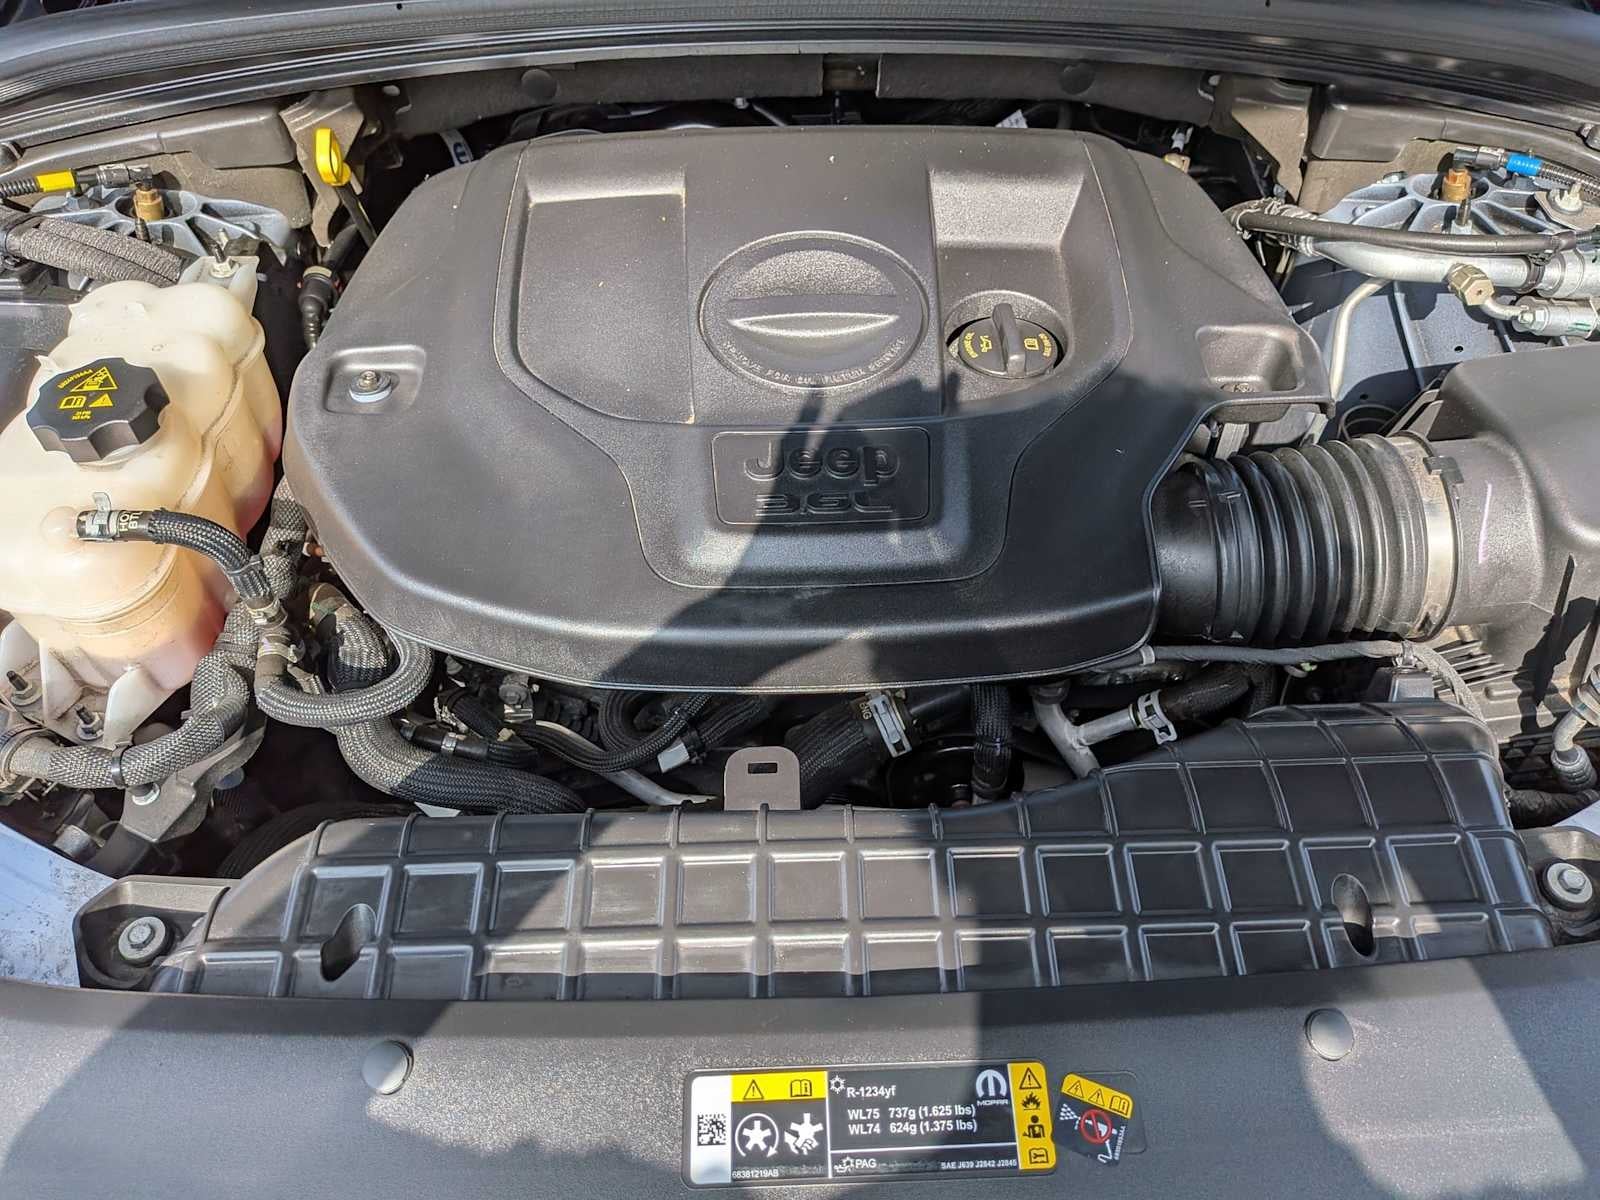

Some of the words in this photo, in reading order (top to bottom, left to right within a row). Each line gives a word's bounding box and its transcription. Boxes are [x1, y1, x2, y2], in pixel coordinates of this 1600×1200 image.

[743, 439, 900, 487] Jeep
[846, 1084, 897, 1099] R-1234yf
[976, 1099, 1009, 1107] MOPAR
[847, 1107, 881, 1121] WL75
[888, 1106, 916, 1121] 737g
[918, 1105, 952, 1118] (1.625
[954, 1103, 977, 1117] lbs)
[848, 1122, 881, 1135] WL74
[889, 1121, 917, 1135] 624g
[919, 1119, 954, 1134] (1.375
[956, 1118, 978, 1133] lbs)
[855, 1158, 877, 1169] PAG
[940, 1161, 957, 1170] SAE
